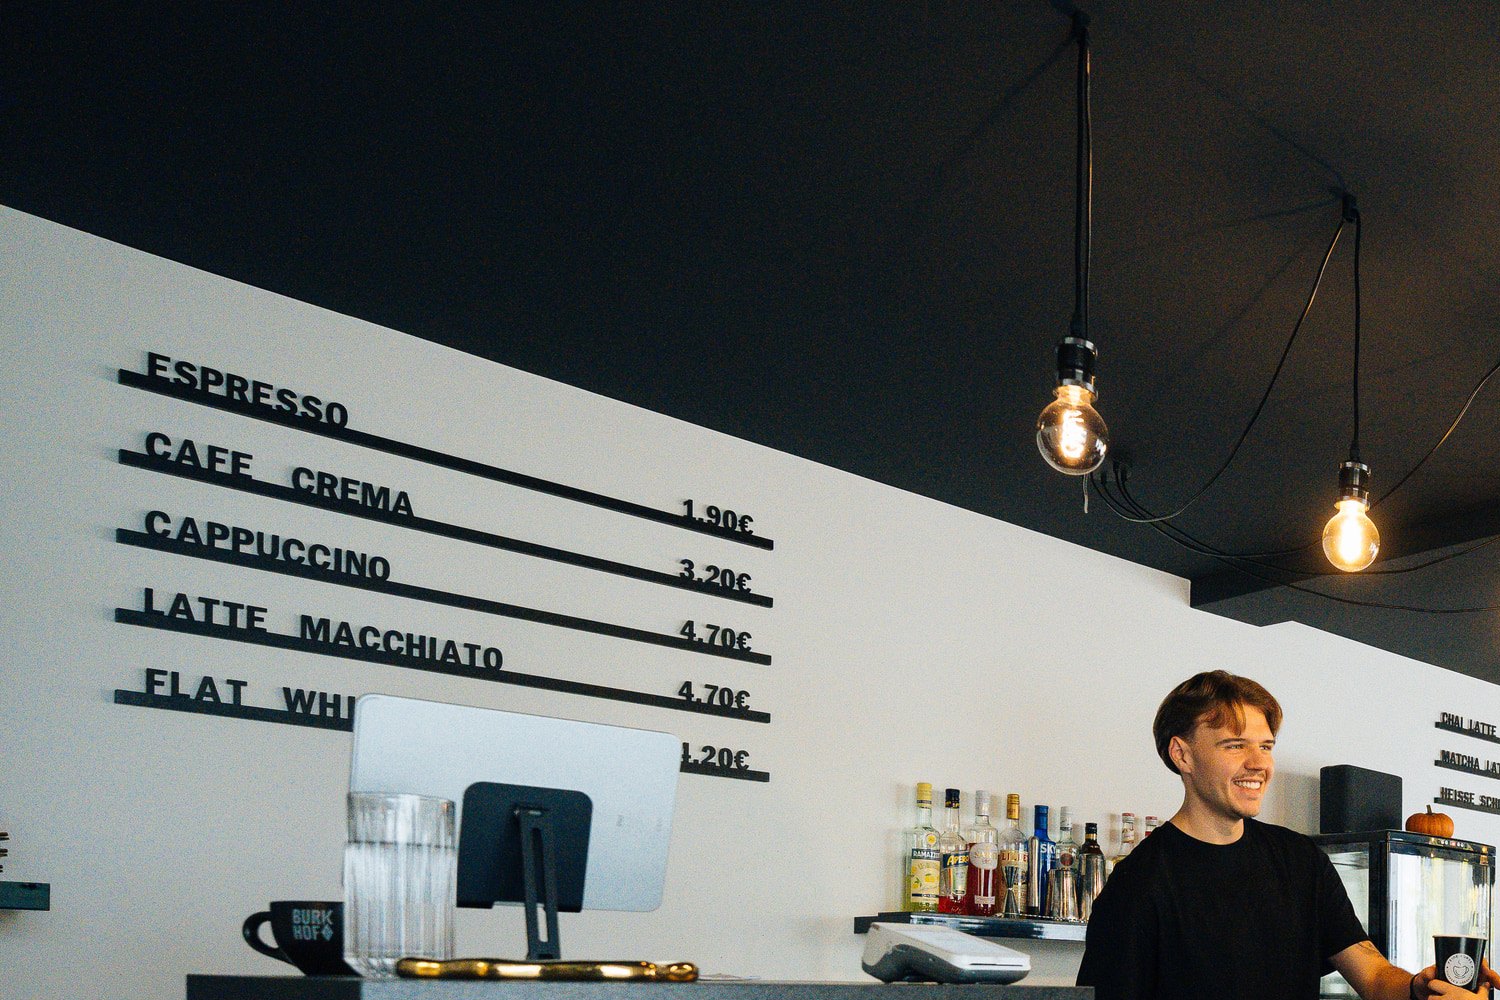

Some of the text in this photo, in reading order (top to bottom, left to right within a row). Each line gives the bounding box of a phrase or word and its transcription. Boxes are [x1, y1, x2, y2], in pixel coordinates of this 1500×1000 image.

[147, 352, 754, 536] ESPRESSO 1.90€
[145, 432, 752, 594] CAFE CREMA 3.20€
[144, 510, 753, 653] CAPPUCCINO 4.70€
[144, 588, 751, 711] LATTE MACCHIATO 4.70€
[145, 668, 248, 706] FLAT
[282, 686, 356, 721] WHI
[1441, 712, 1463, 729] CHAI
[1469, 719, 1497, 738] LATTE
[1440, 786, 1475, 805] HEISSE
[1441, 749, 1480, 770] MATCHA
